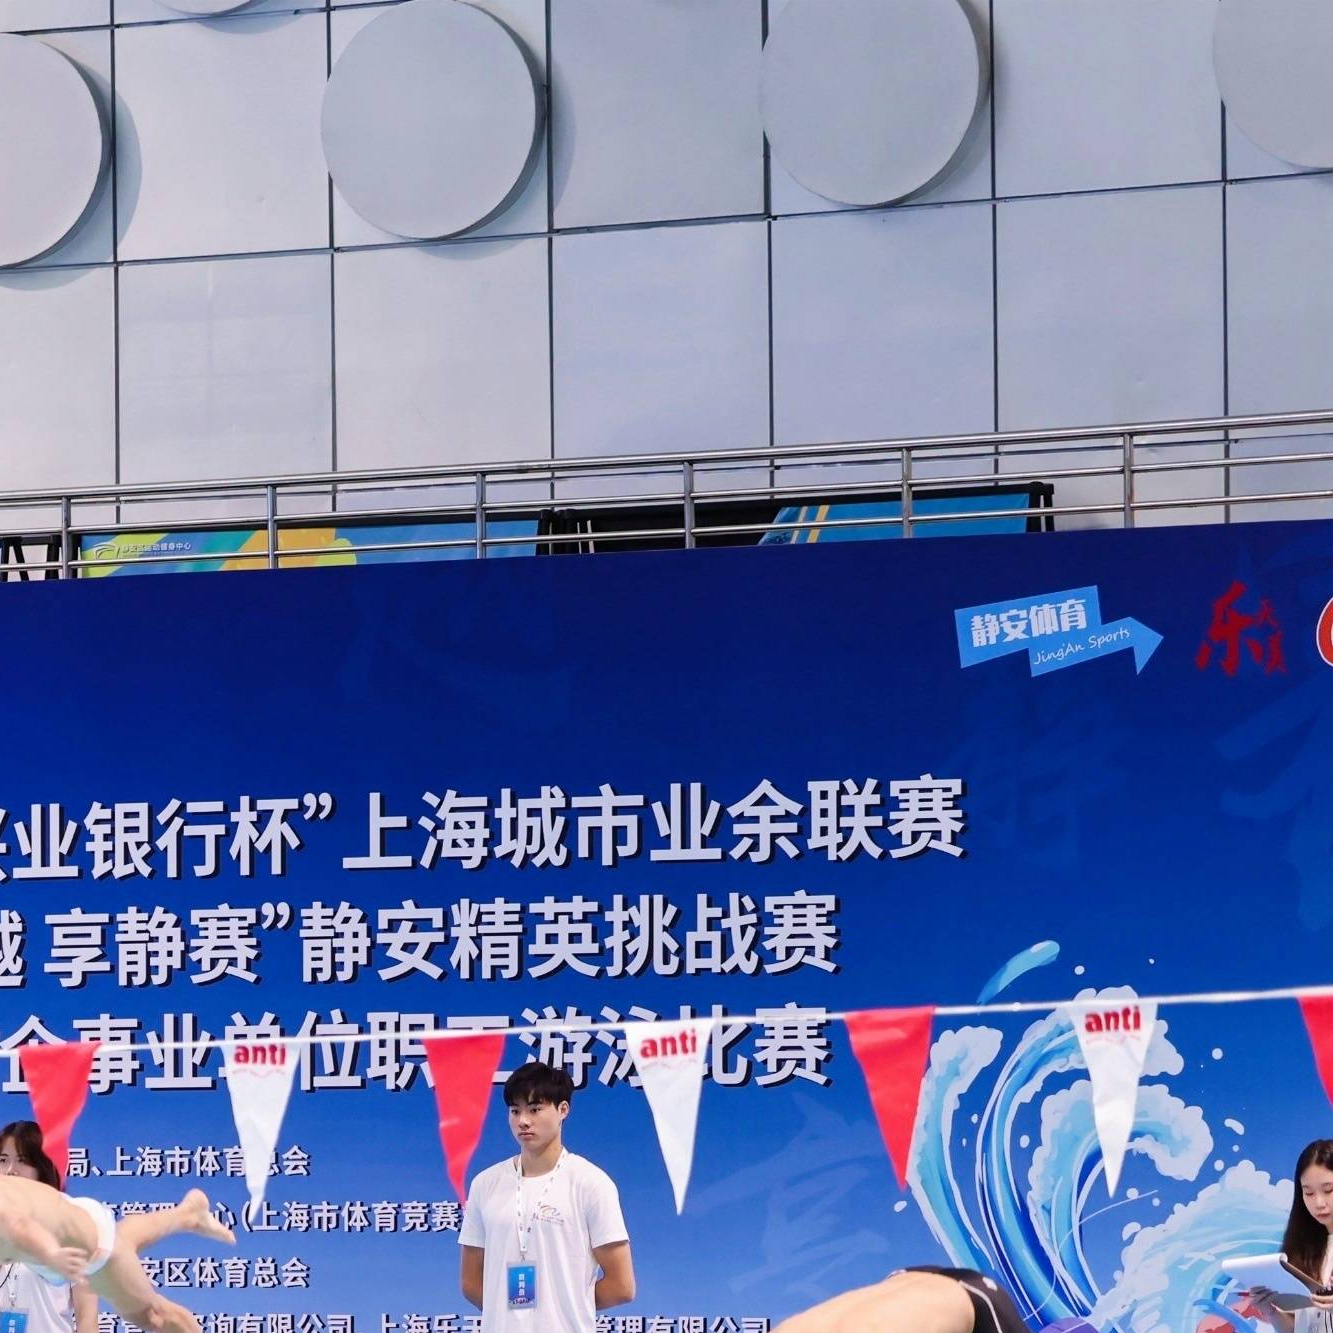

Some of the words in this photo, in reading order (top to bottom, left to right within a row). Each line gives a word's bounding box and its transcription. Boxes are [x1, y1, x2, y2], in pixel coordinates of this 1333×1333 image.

[971, 599, 1088, 648] 静安体育
[1088, 627, 1131, 648] Sports
[1084, 1004, 1142, 1037] anti
[233, 1043, 287, 1067] anti
[639, 1029, 698, 1060] anti
